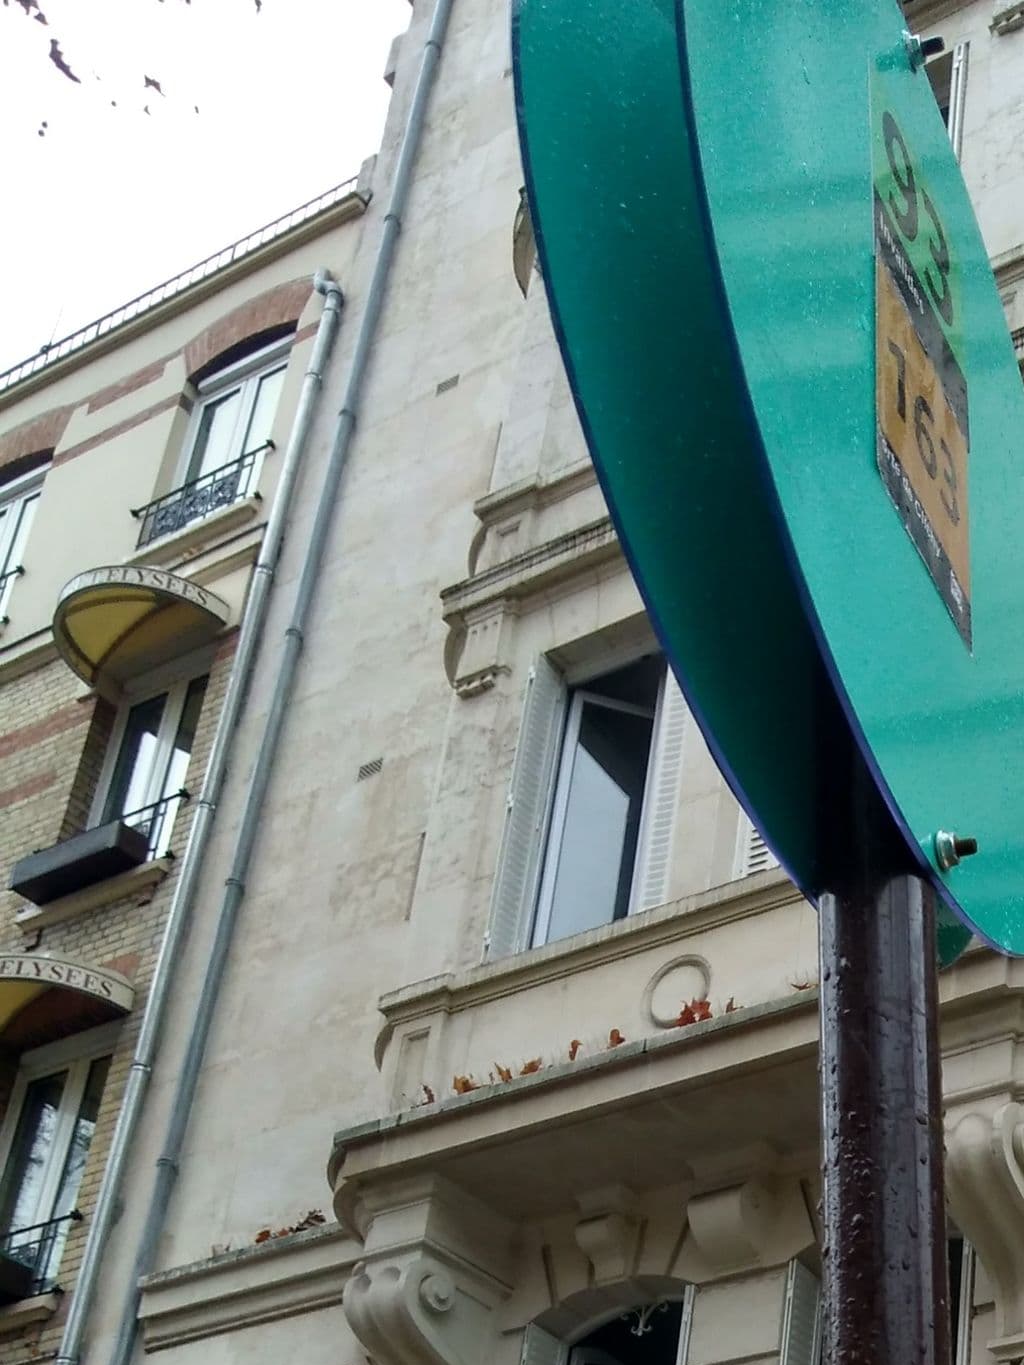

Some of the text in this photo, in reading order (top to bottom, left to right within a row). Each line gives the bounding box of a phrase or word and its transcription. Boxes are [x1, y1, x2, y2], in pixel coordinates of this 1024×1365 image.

[879, 210, 926, 315] Invalides
[882, 111, 953, 327] 93
[886, 337, 960, 527] 163
